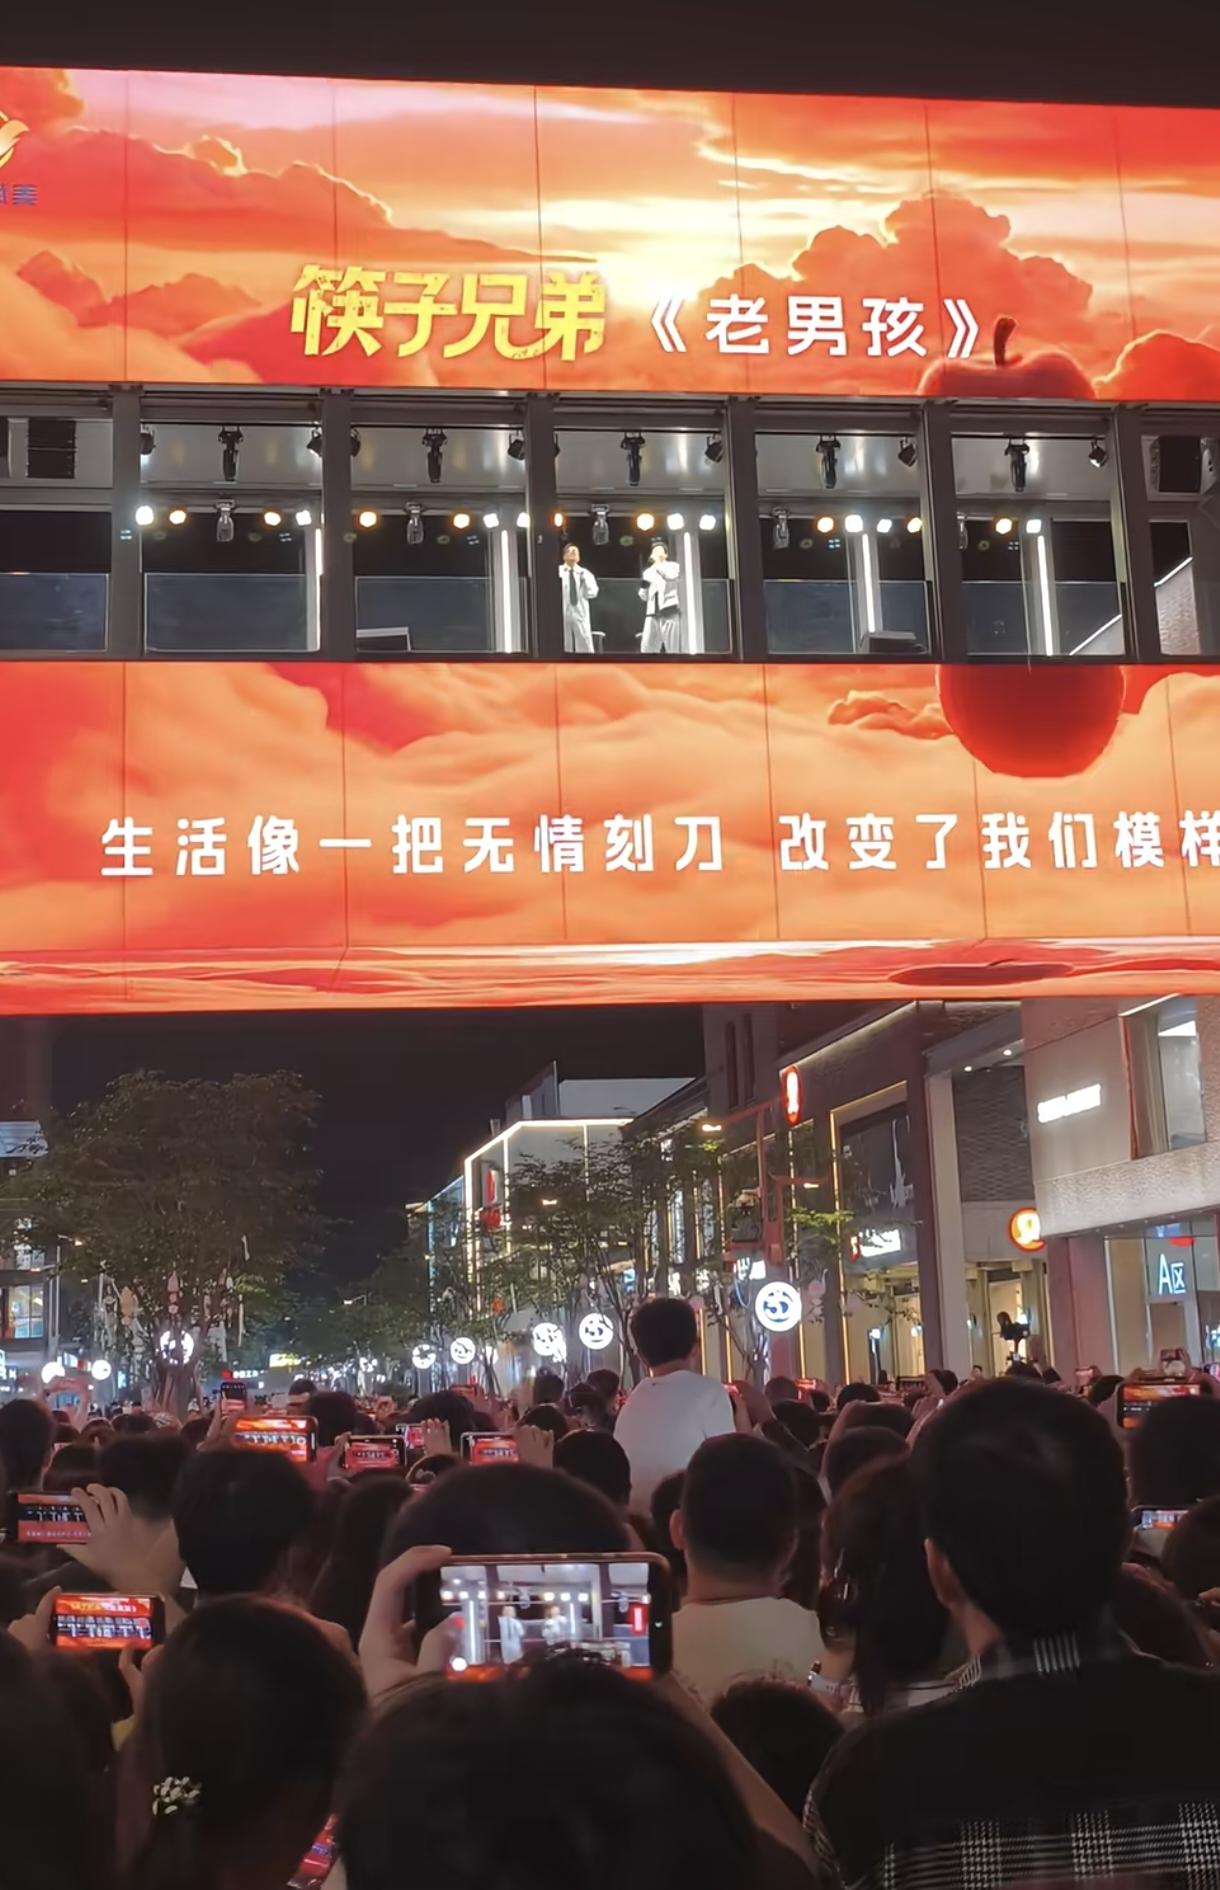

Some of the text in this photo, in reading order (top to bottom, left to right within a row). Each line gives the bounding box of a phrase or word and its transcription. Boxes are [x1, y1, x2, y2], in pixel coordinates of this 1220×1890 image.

[0, 183, 38, 206] 美
[290, 263, 979, 361] 筷子兄弟 《老男孩》
[101, 810, 1220, 877] 生活像一把无情刻刀 改变了我们模样
[1158, 1253, 1187, 1295] A区
